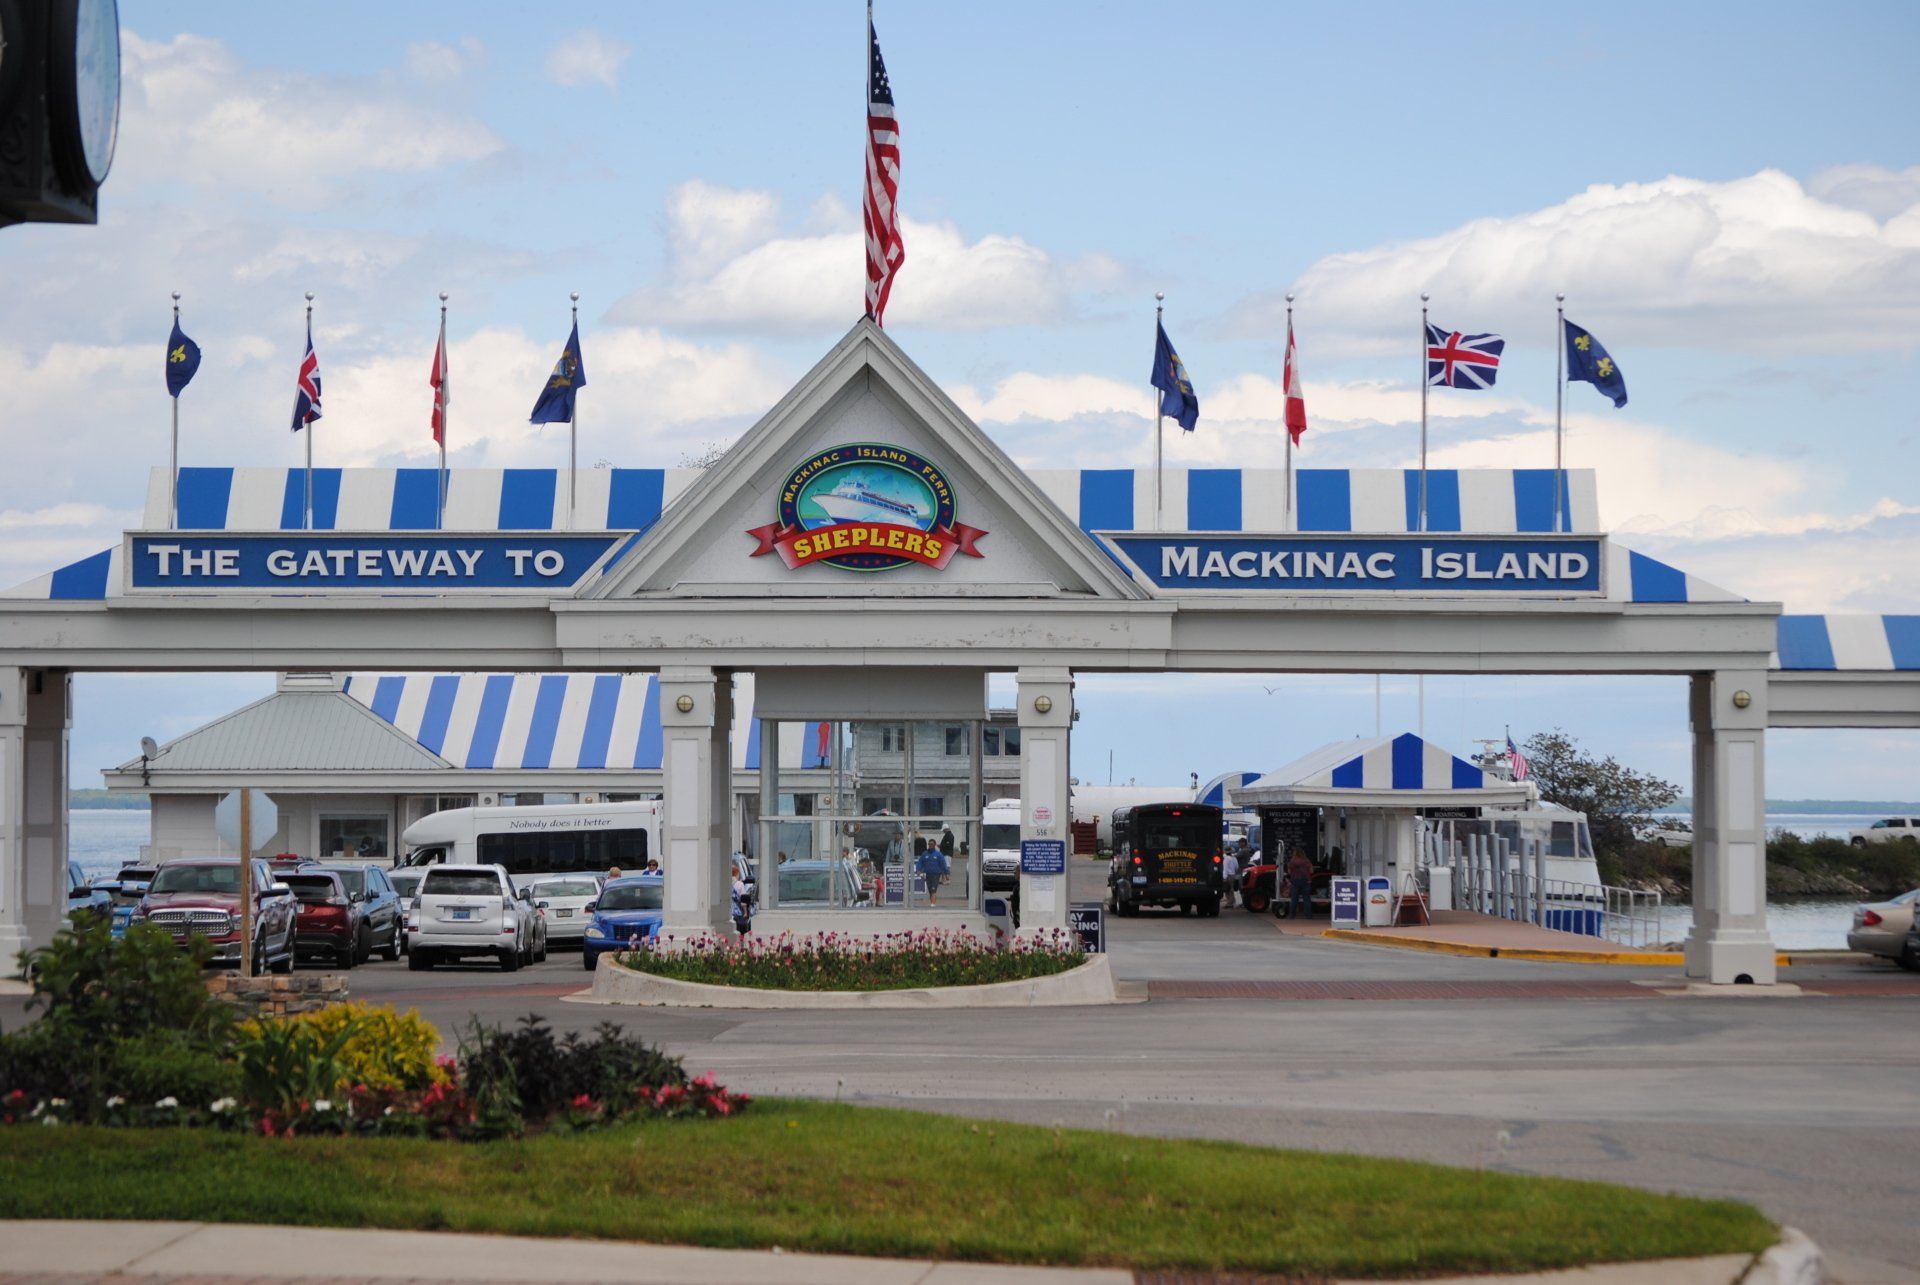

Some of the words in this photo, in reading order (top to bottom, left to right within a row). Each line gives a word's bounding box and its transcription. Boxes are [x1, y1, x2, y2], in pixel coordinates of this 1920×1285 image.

[783, 452, 840, 503] MACKINAC
[858, 447, 907, 463] ISLAND
[922, 466, 951, 506] FERRY
[793, 528, 943, 559] SHEPLER'S
[147, 544, 240, 577] THE
[266, 549, 483, 577] GATEWAY
[505, 549, 565, 577] TO
[1160, 546, 1396, 579] MACKINAC
[1420, 547, 1590, 579] ISLAND
[510, 820, 547, 830] Nobody
[549, 819, 571, 828] does
[574, 818, 581, 827] it
[583, 818, 612, 827] better
[1036, 828, 1048, 837] 556
